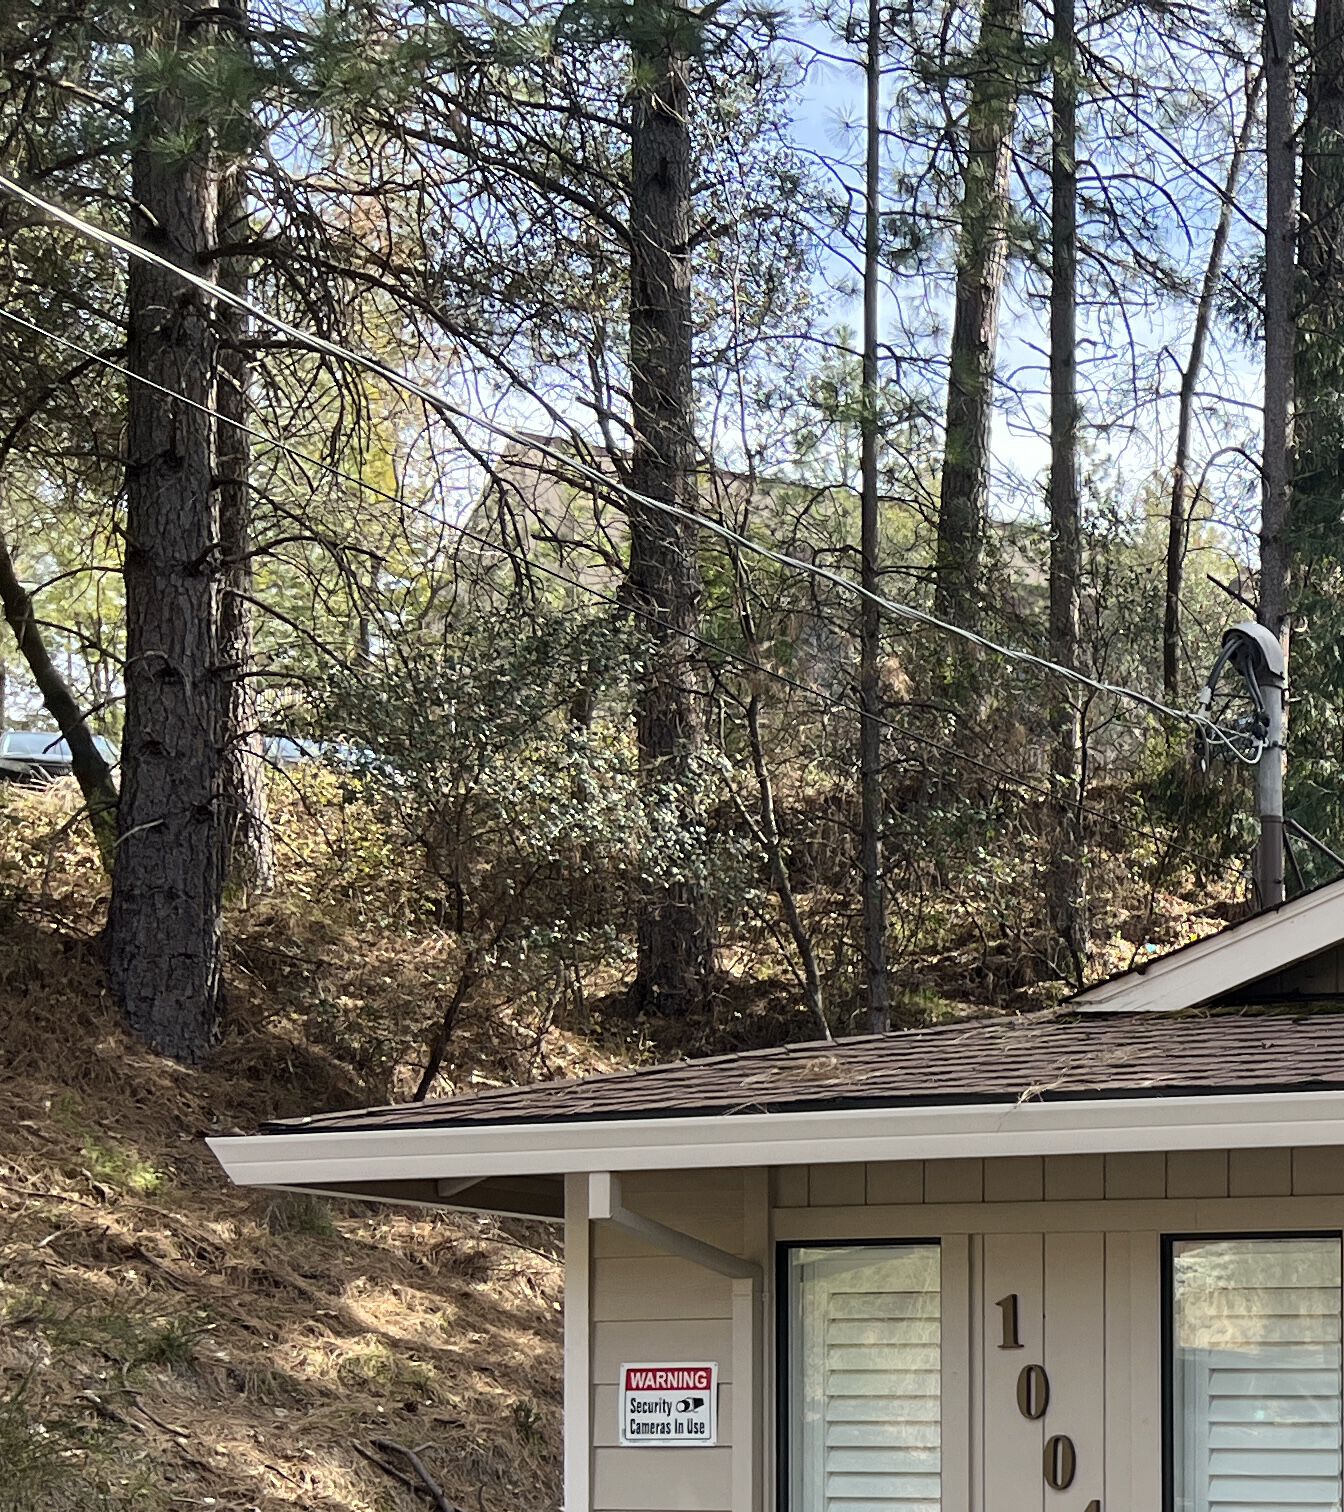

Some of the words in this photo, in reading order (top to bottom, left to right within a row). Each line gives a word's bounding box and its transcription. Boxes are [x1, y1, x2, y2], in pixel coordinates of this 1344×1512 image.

[630, 1371, 707, 1389] WARNING
[630, 1397, 672, 1417] Security
[630, 1418, 671, 1435] Cameras
[674, 1418, 684, 1435] In
[687, 1418, 705, 1435] Use
